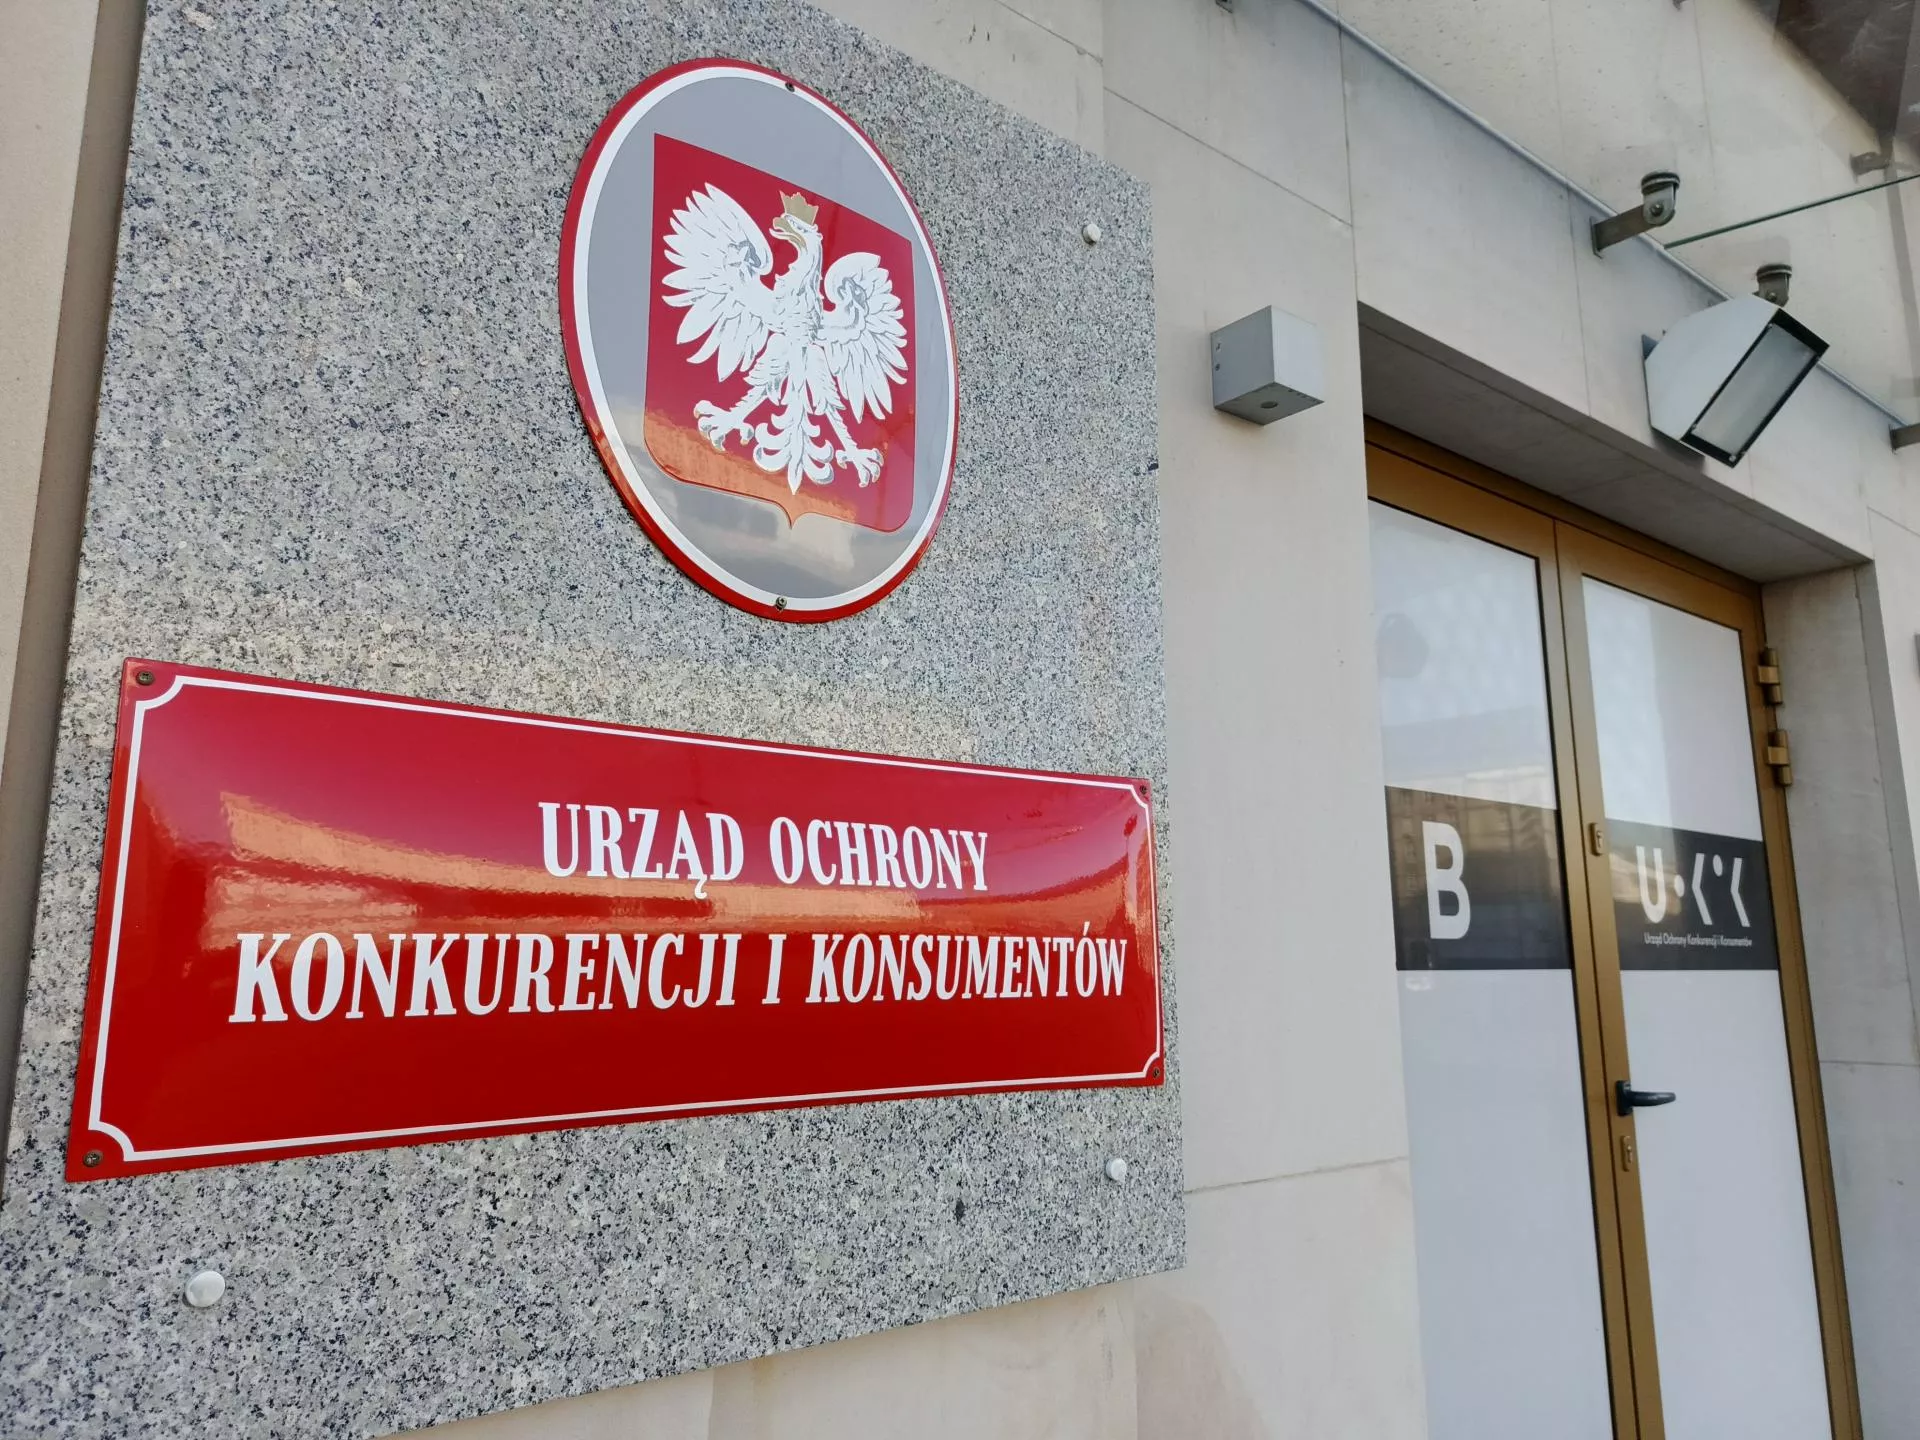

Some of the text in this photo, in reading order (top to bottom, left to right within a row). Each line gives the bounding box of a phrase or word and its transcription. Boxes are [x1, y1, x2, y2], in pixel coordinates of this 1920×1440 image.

[538, 801, 989, 899] URZĄD OCHRONY
[1422, 820, 1471, 940] B
[228, 921, 1128, 1023] KONKURENCJI I KONSUMENTÓW
